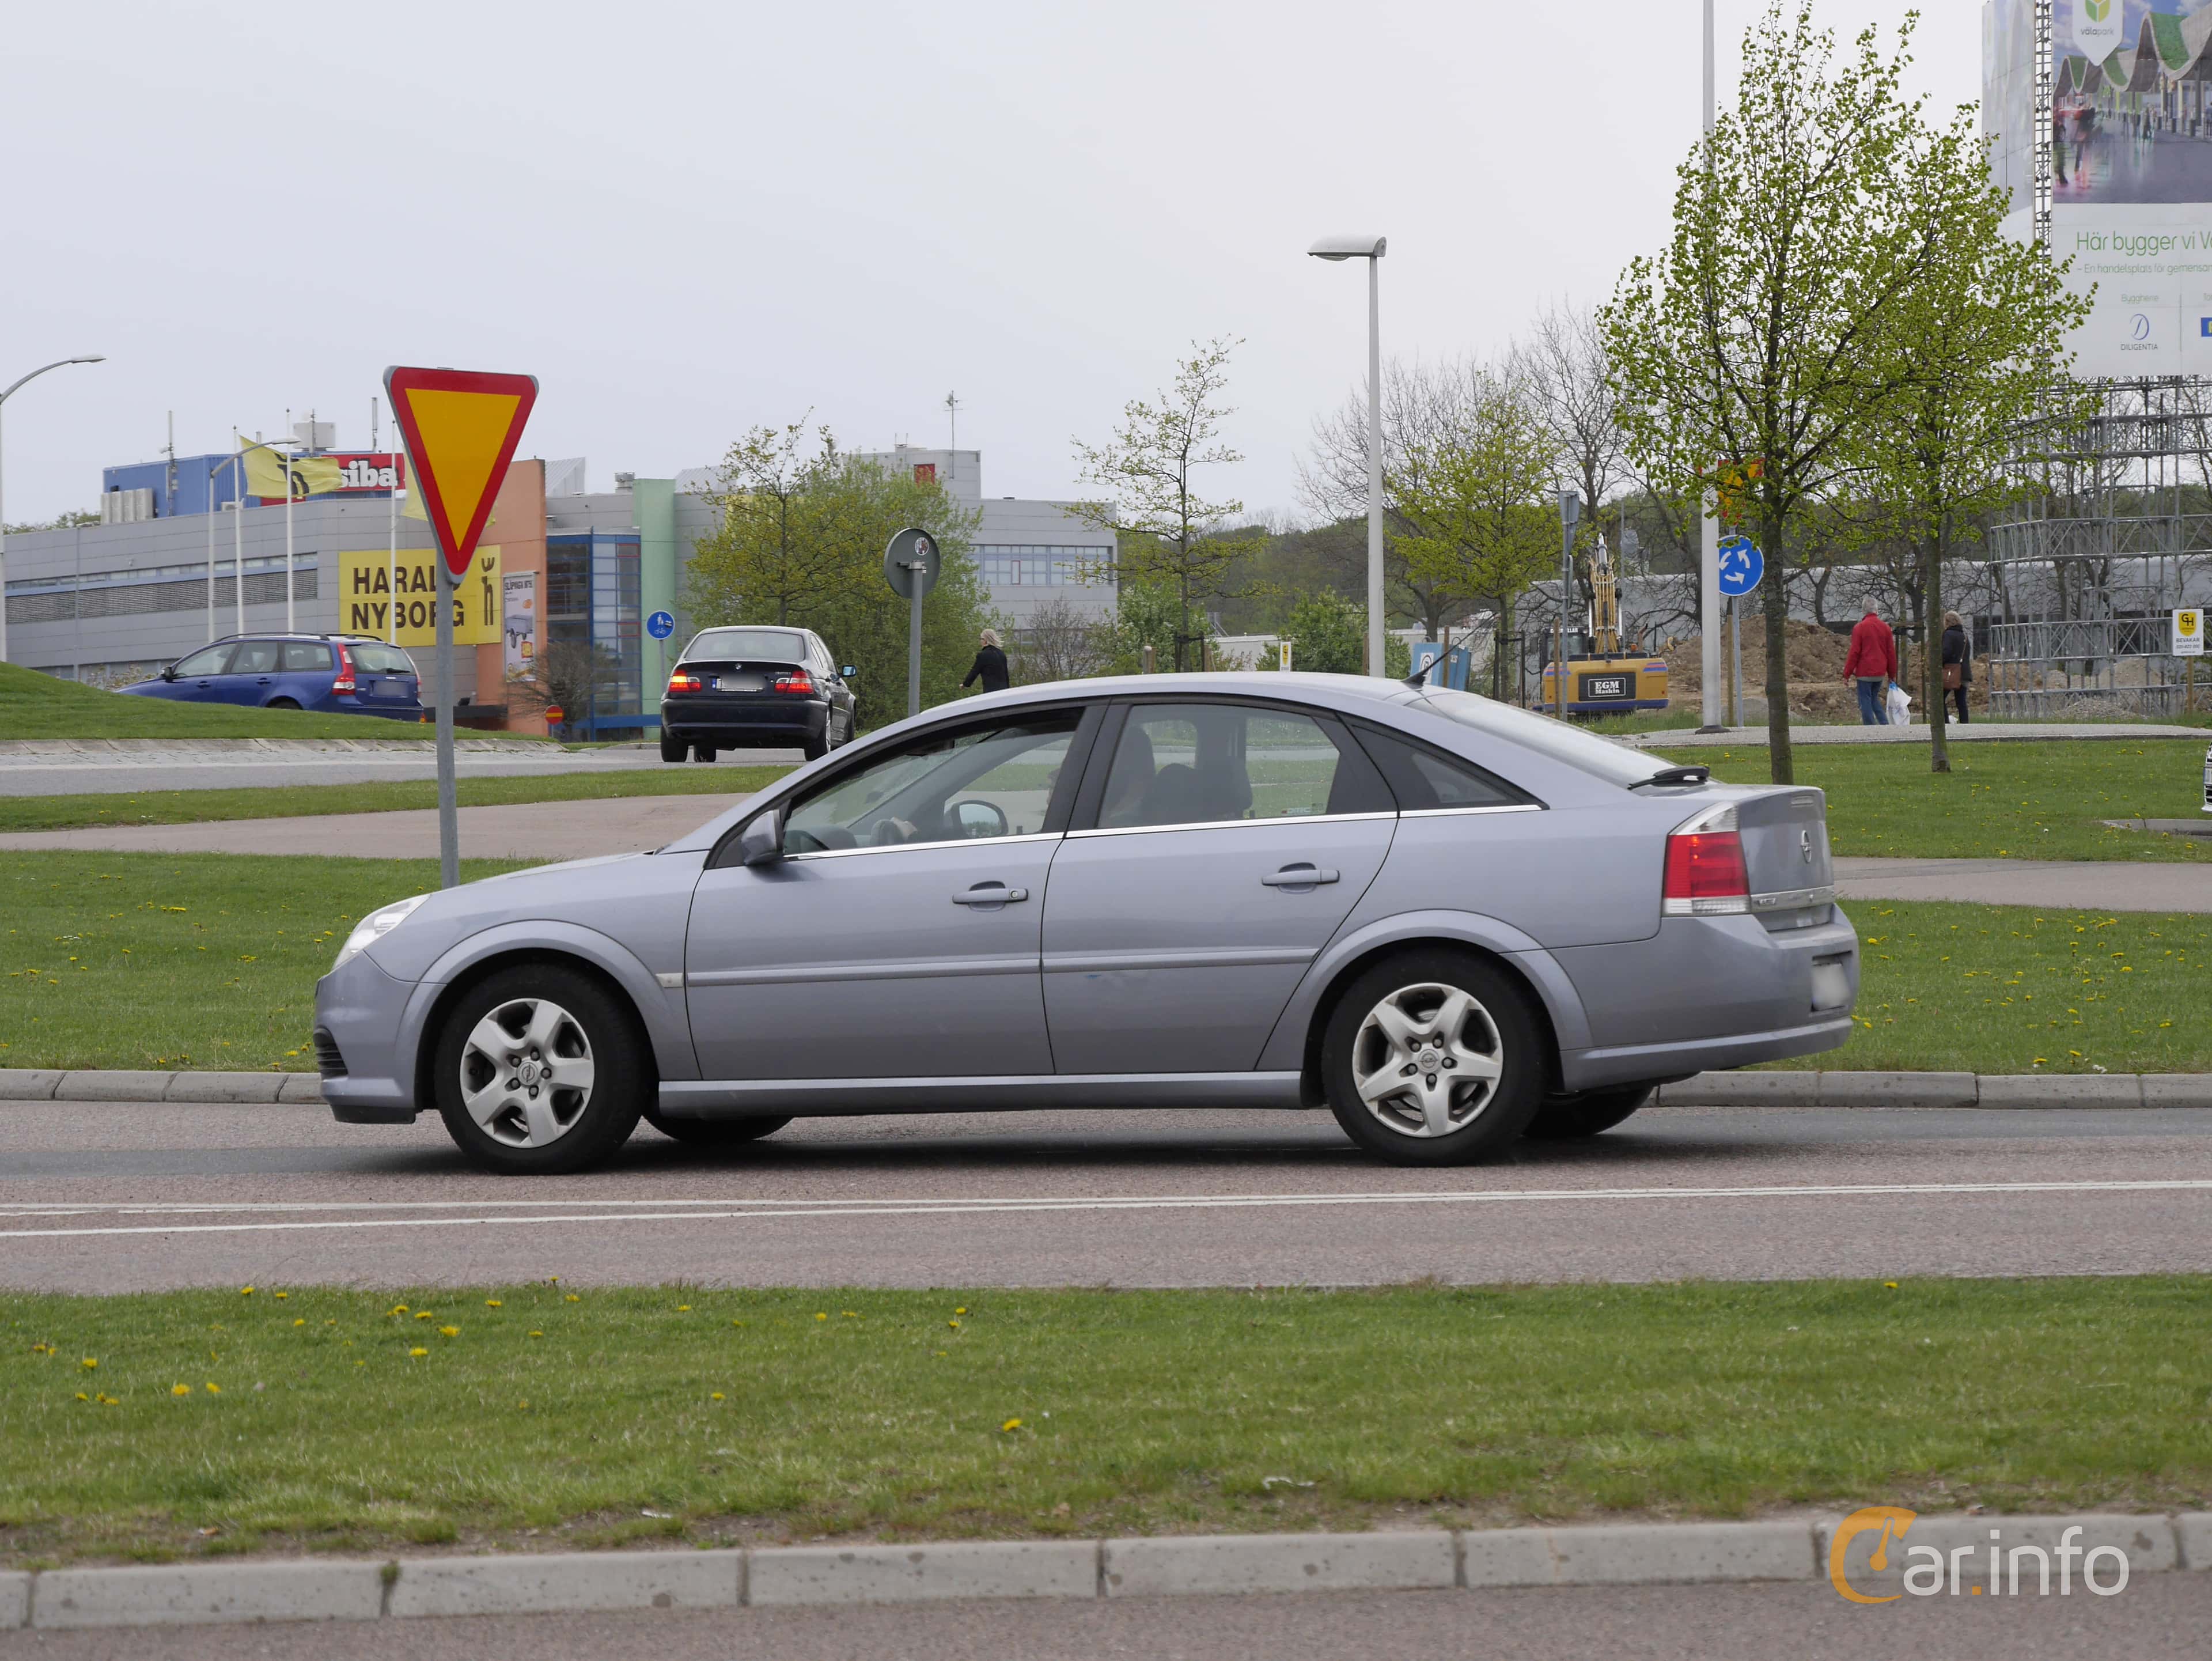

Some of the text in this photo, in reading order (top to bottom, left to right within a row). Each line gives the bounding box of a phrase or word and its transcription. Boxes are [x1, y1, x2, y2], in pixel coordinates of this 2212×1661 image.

[2076, 230, 2212, 256] Här bygger vi V
[2084, 264, 2096, 274] En
[2097, 263, 2152, 275] handelsplats
[353, 565, 461, 595] HARAL
[1594, 681, 1620, 689] EGM
